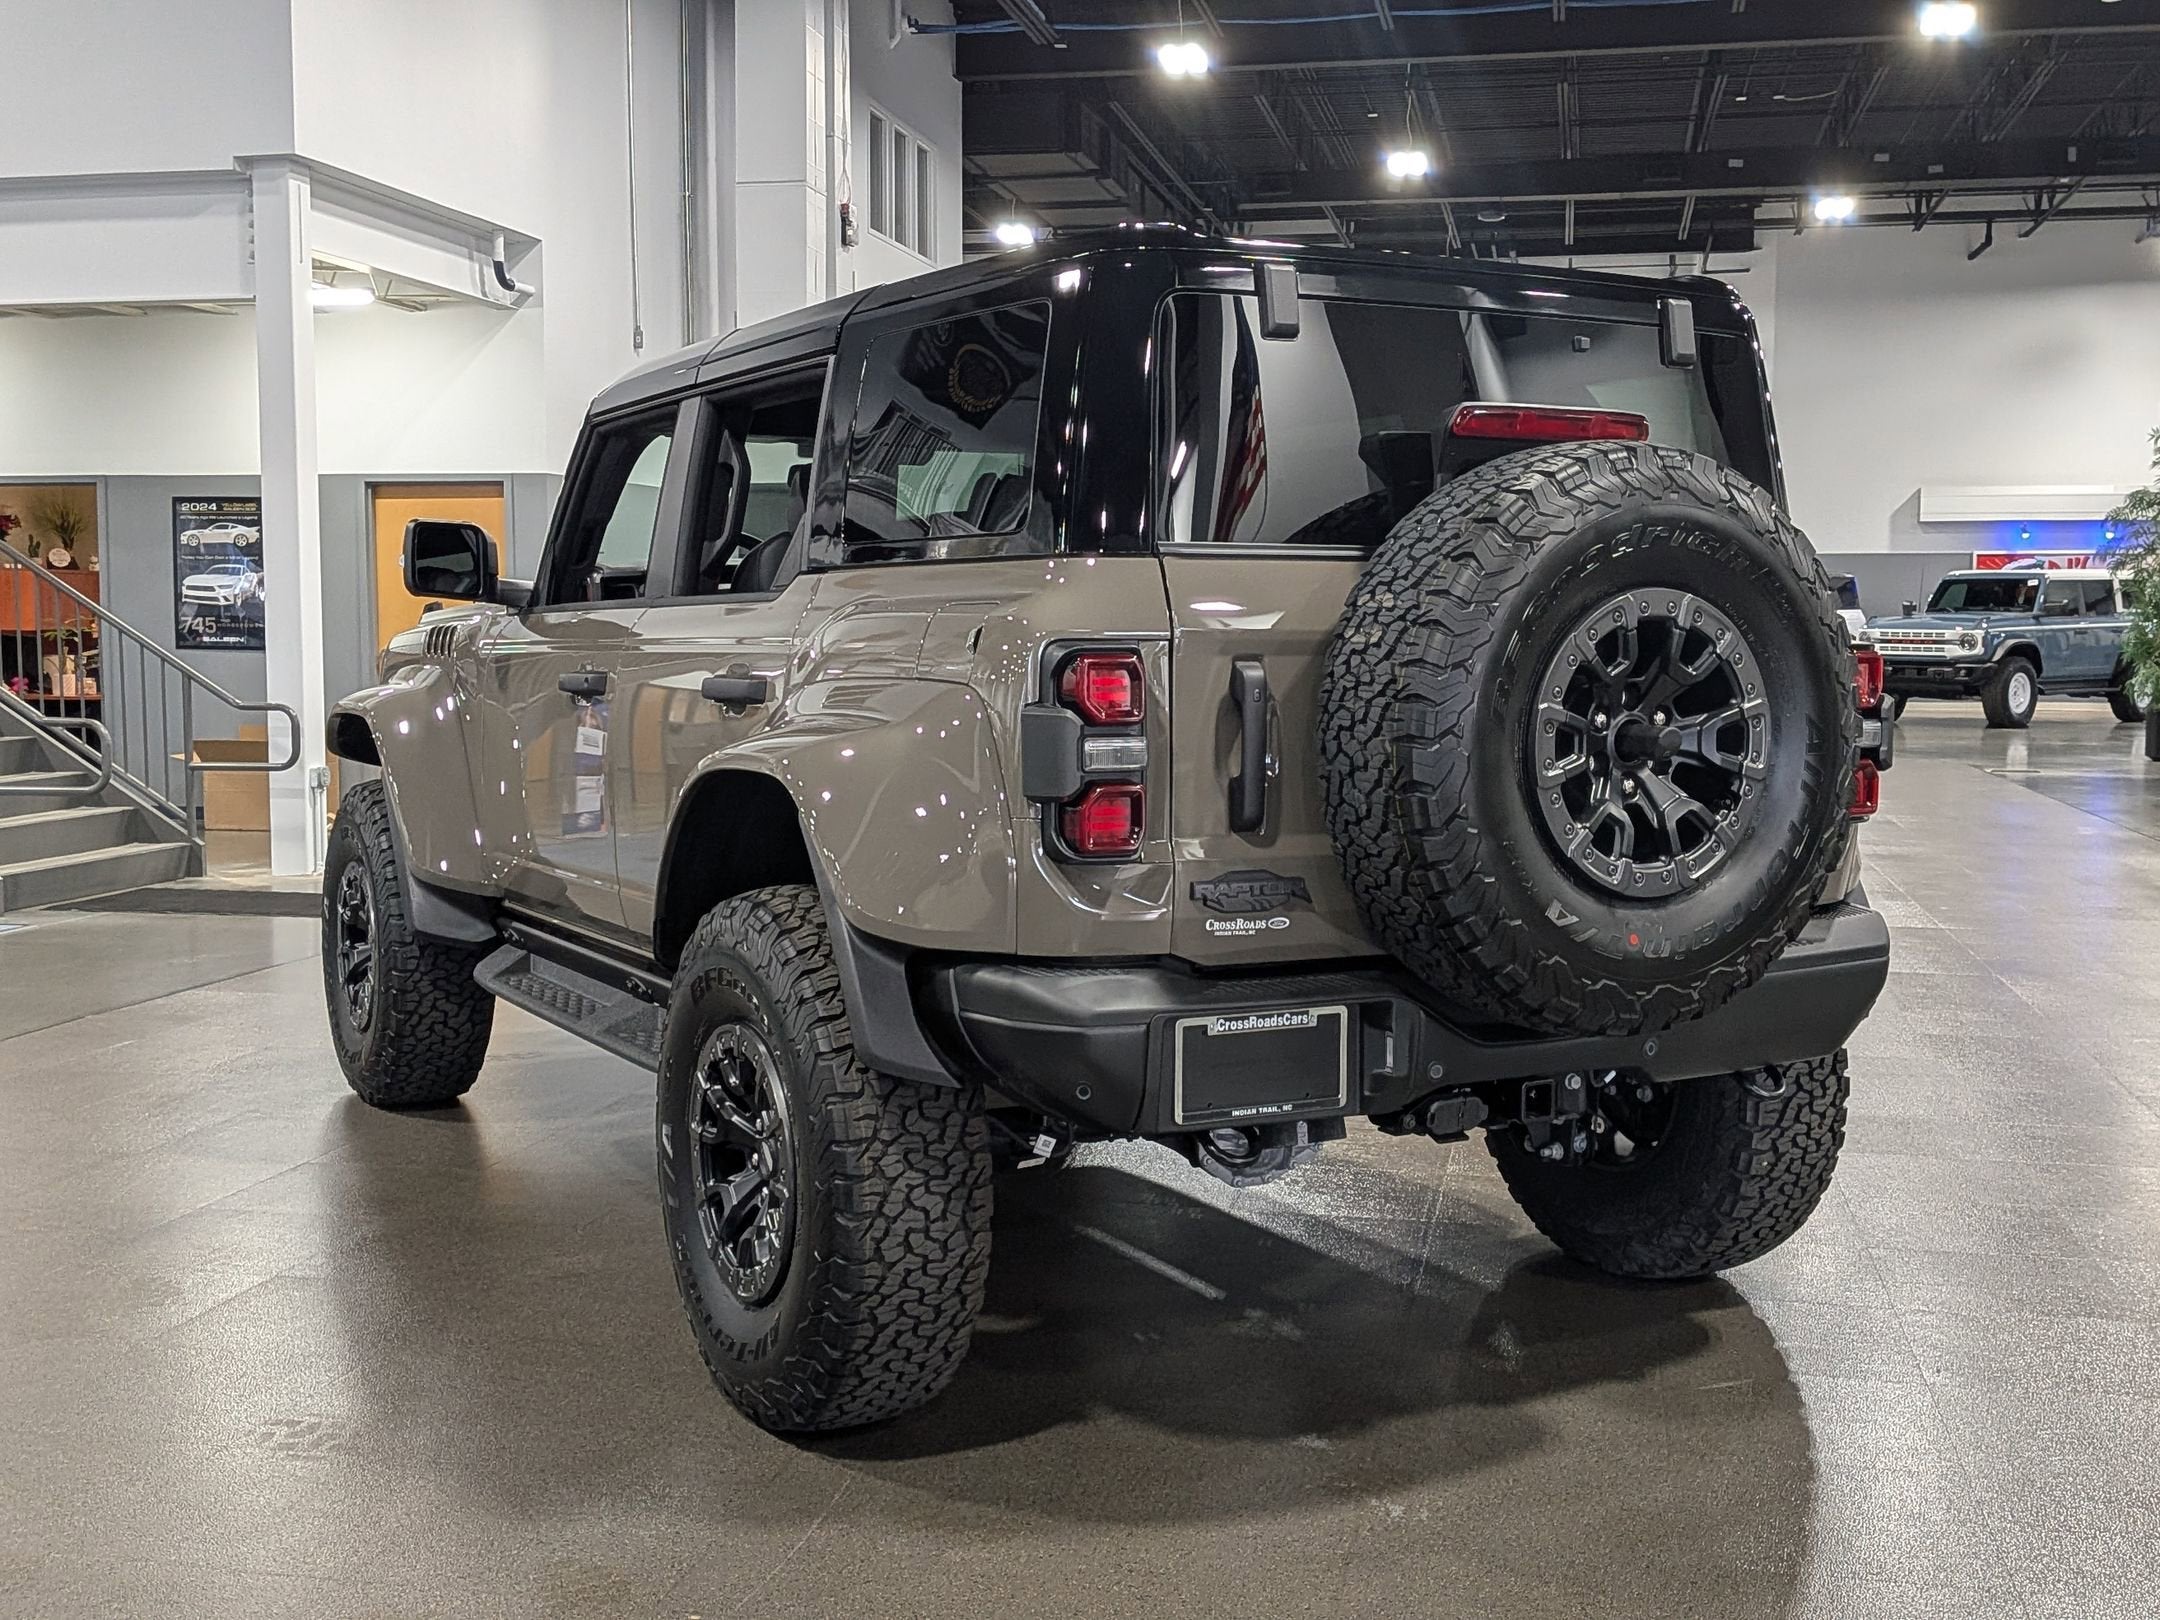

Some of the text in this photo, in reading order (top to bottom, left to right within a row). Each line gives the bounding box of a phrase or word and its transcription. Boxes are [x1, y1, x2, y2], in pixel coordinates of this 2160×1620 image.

[181, 502, 217, 511] 2024
[180, 616, 217, 634] 745
[1190, 878, 1312, 905] RAPTOR
[1217, 1012, 1308, 1032] CrossRoadsCars
[1231, 1107, 1257, 1117] INDIAN
[1258, 1105, 1281, 1114] TRAIL,
